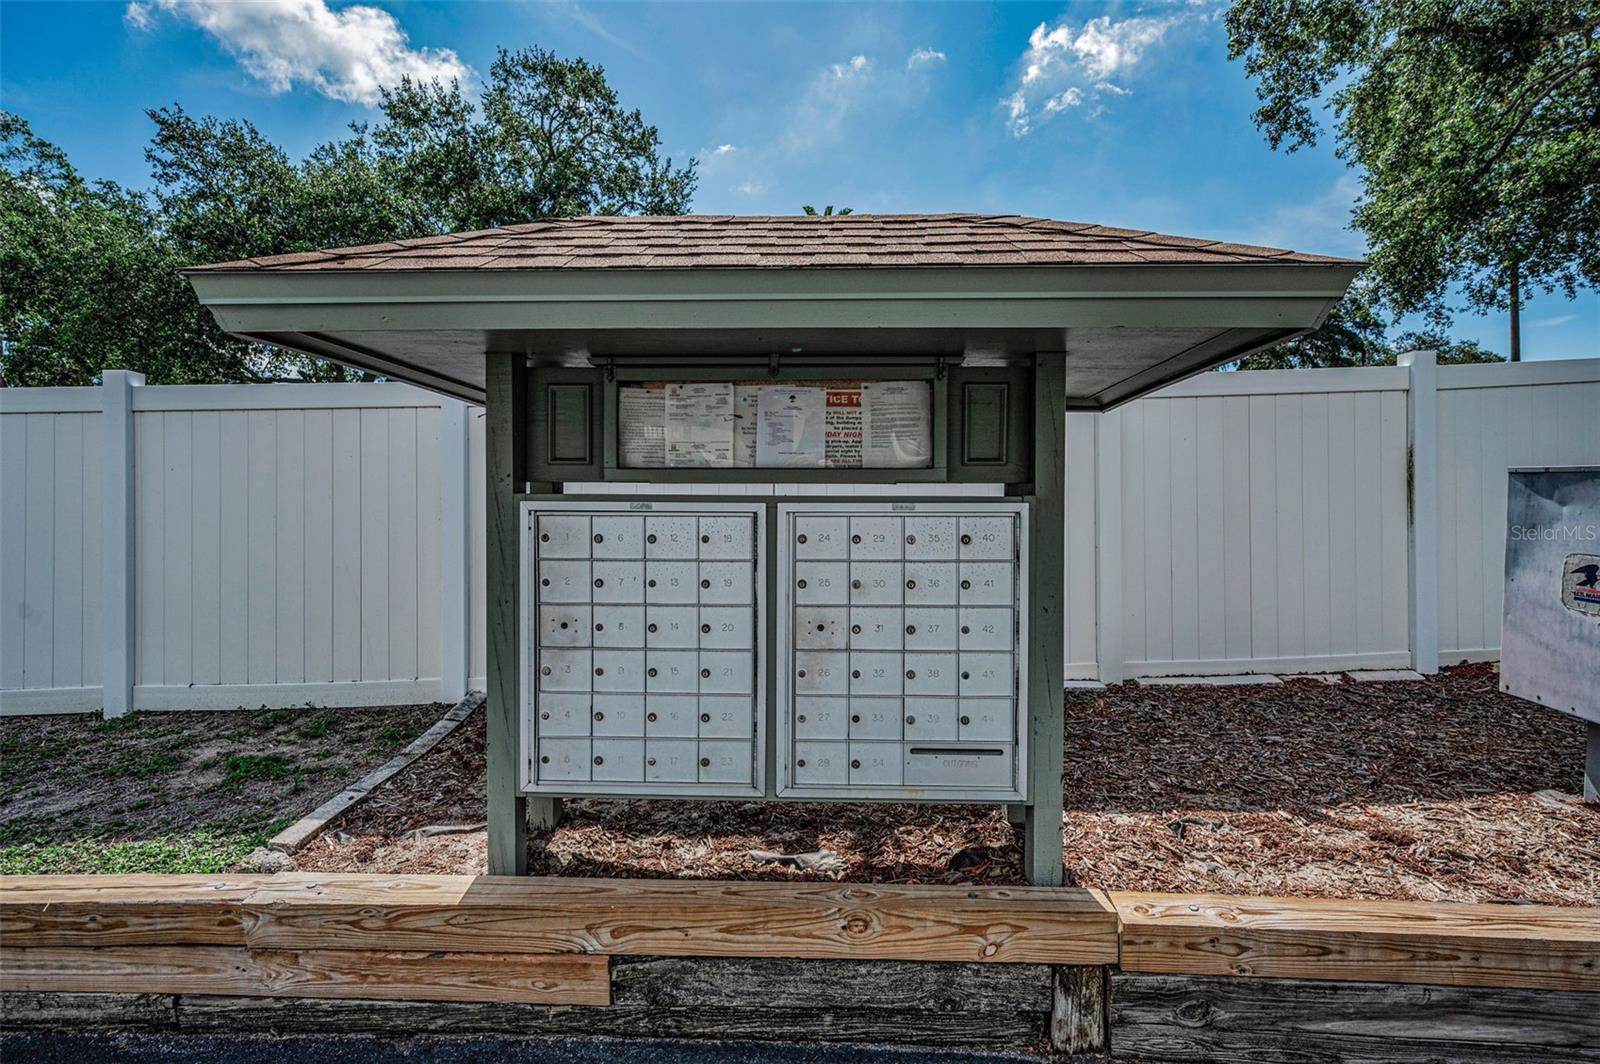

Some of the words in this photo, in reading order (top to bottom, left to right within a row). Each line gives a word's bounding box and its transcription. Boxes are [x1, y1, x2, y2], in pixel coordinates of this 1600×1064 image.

[566, 532, 569, 541] 1
[617, 533, 624, 543] 6
[670, 533, 679, 543] 12
[723, 534, 732, 543] 18
[818, 533, 831, 542] 24
[873, 534, 886, 543] 29
[928, 534, 940, 542] 35
[982, 533, 996, 542] 40
[564, 576, 571, 586] 2
[618, 577, 624, 587] 7
[670, 577, 679, 587] 13
[723, 578, 733, 587] 19
[818, 578, 831, 587] 25
[872, 579, 886, 588] 30
[927, 579, 940, 588] 36
[983, 579, 994, 588] 41
[618, 622, 625, 631] 8
[721, 623, 735, 632] 20
[874, 624, 884, 633] 31
[927, 625, 940, 633] 37
[982, 625, 995, 634] 42
[564, 665, 571, 674] 3
[617, 666, 625, 675] 9
[670, 666, 679, 676] 15
[722, 667, 733, 677] 21
[817, 668, 831, 677] 26
[872, 669, 885, 678] 32
[927, 669, 940, 678] 38
[982, 670, 996, 679] 43
[617, 711, 626, 720] 10
[669, 712, 679, 721] 16
[721, 712, 734, 722] 22
[817, 712, 831, 722] 27
[872, 713, 884, 722] 33
[927, 714, 940, 723] 39
[670, 756, 679, 766] 17
[720, 757, 733, 766] 23
[817, 758, 831, 768] 28
[871, 759, 884, 767] 34
